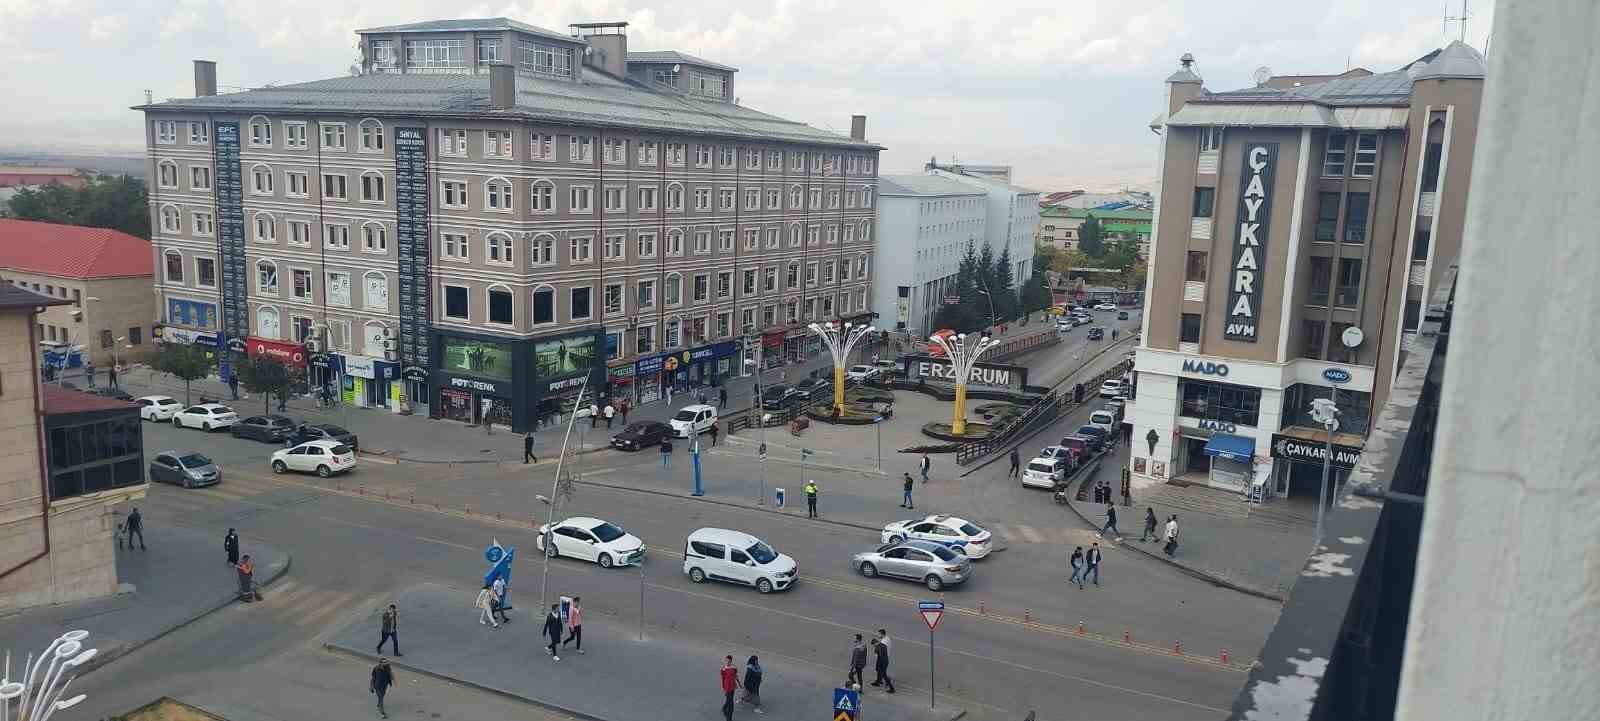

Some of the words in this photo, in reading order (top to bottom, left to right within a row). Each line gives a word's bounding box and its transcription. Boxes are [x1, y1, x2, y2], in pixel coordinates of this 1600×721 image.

[1231, 146, 1268, 317] ÇAYKARA
[1225, 322, 1255, 337] AVM
[919, 361, 1009, 385] ERZRUM
[1182, 358, 1229, 377] MADO
[1326, 370, 1348, 381] MADO
[1198, 418, 1237, 434] MADO
[1336, 451, 1360, 464] AVM
